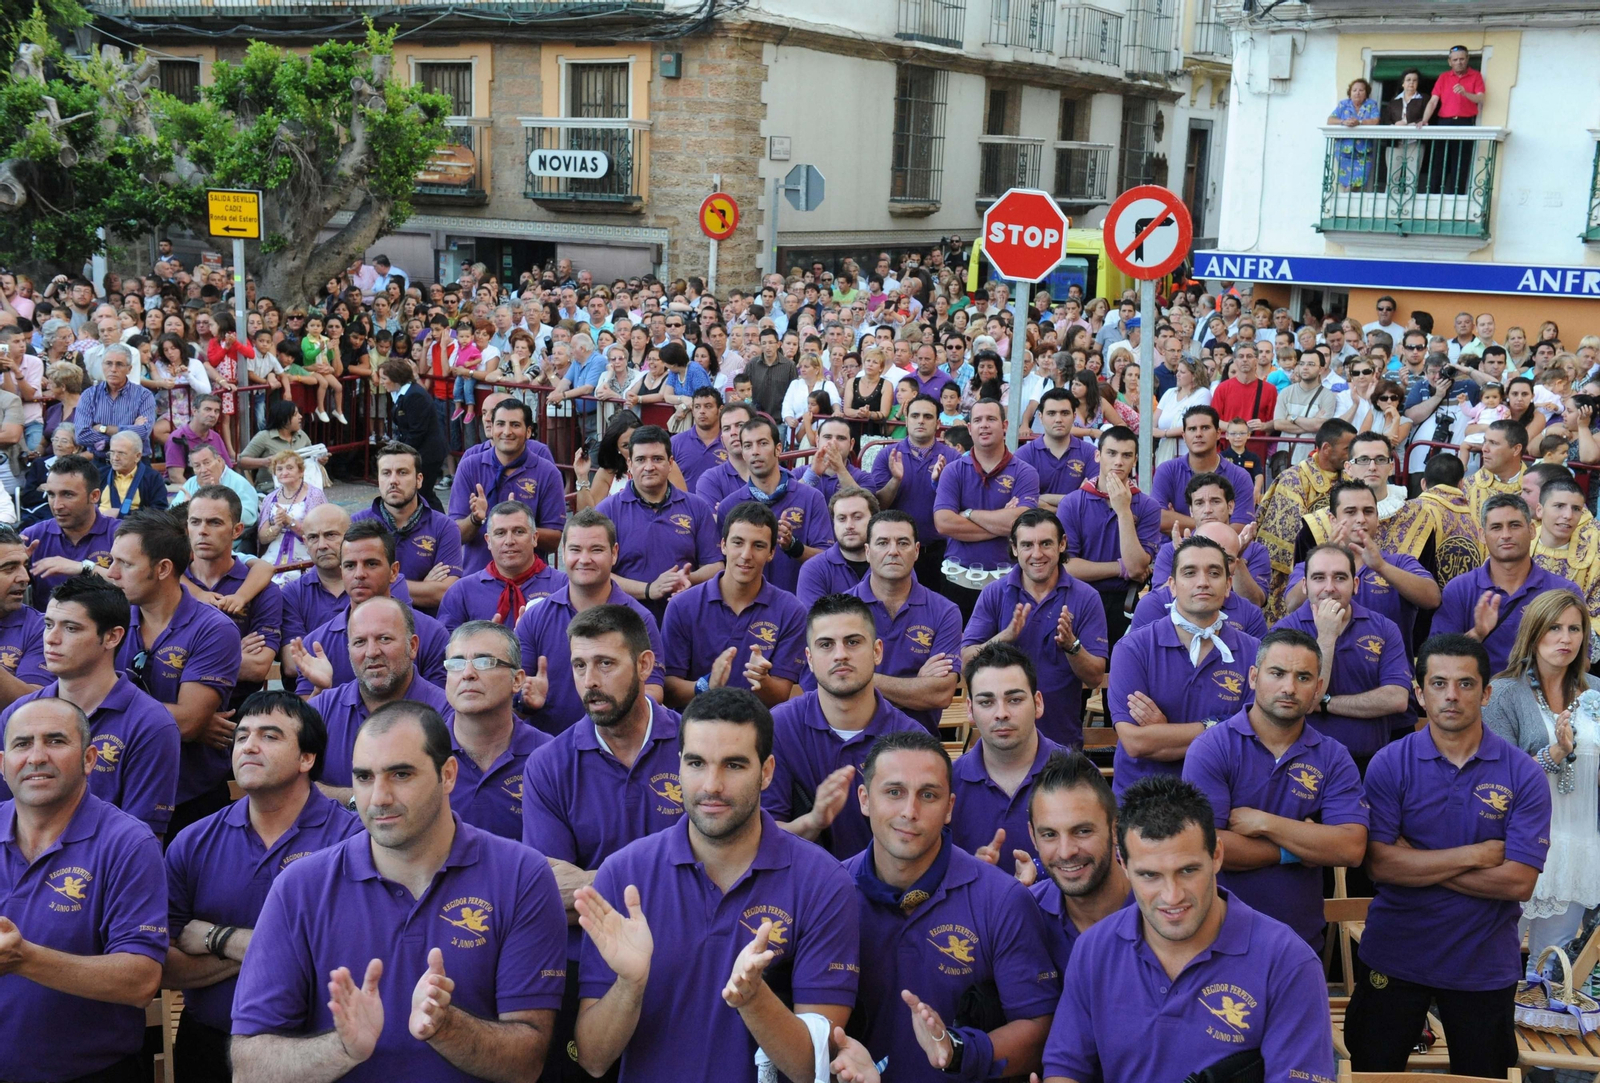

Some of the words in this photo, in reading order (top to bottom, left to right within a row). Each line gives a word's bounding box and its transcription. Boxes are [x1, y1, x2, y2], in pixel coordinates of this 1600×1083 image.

[538, 154, 599, 173] NOVIAS
[233, 195, 256, 203] SEVILLA
[239, 215, 258, 223] Estero
[988, 221, 1060, 249] STOP
[1204, 255, 1294, 280] ANFRA
[1516, 268, 1600, 294] ANFR
[651, 773, 670, 784] REGIDOR
[282, 851, 303, 865] REGIDOR
[49, 867, 72, 880] REGIDOR
[72, 867, 93, 882] PERPETUO
[54, 904, 71, 912] JUNIO
[442, 897, 467, 912] REGIDOR
[467, 897, 493, 912] PERPETUO
[743, 905, 767, 919] REGIDOR
[768, 905, 793, 925] PERPETUO
[929, 924, 954, 938] REGIDOR
[954, 924, 979, 944] PERPETUO
[457, 939, 475, 948] JUNIO
[944, 966, 961, 975] JUNIO
[1201, 983, 1229, 997] REGIDOR
[1229, 984, 1257, 1009] PERPETUO
[1205, 1025, 1214, 1035] 26
[1212, 1029, 1231, 1042] JUNIO
